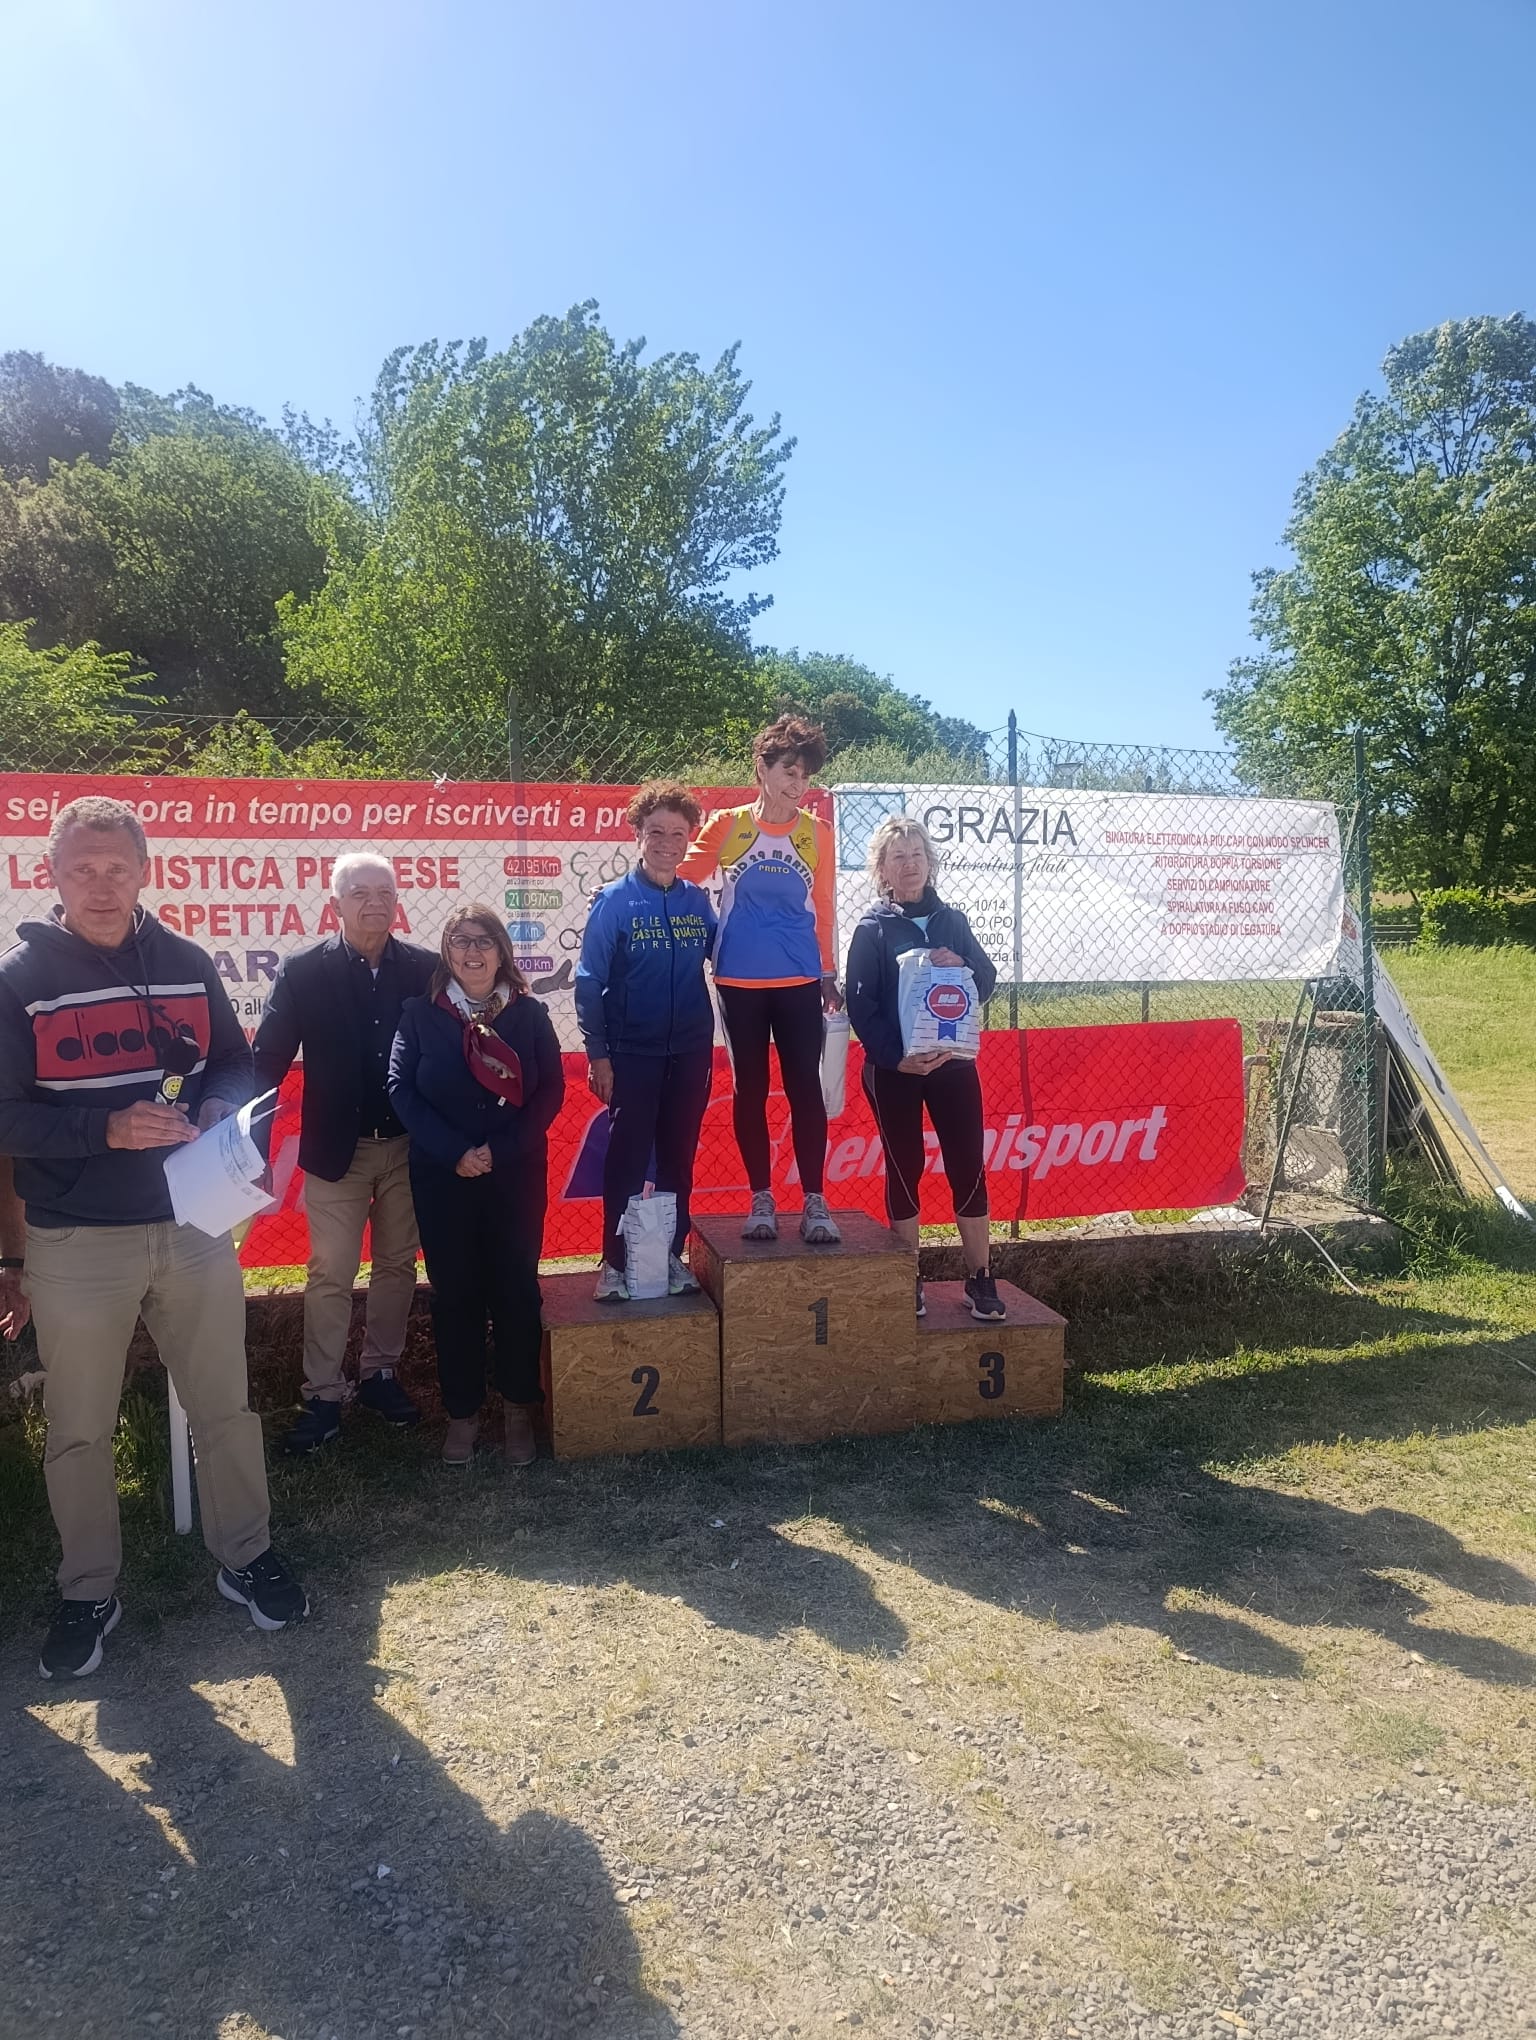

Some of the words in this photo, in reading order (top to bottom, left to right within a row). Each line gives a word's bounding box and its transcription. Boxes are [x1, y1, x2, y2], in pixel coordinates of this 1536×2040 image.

[206, 796, 236, 824] in
[248, 797, 350, 832] tempo
[361, 802, 416, 832] per
[425, 798, 561, 828] iscriverti
[569, 806, 586, 827] a
[923, 805, 1077, 846] GRAZIA
[1105, 831, 1145, 844] BINATURA
[1147, 833, 1201, 846] ELETTRONICA
[1247, 836, 1264, 848] CON
[1265, 836, 1288, 848] NODO
[758, 864, 790, 874] PRATO
[772, 849, 813, 889] MARTIRI
[1155, 856, 1208, 868] RITORCITURA
[1241, 857, 1281, 870] TORSIONE
[143, 855, 284, 890] ISTICA
[1167, 879, 1197, 891] SERVIZI
[1208, 879, 1271, 892] CAMPIONATURE
[975, 899, 1006, 911] 10/14
[1167, 901, 1220, 913] SPIRALATURA
[1228, 902, 1251, 914] FUSO
[1252, 902, 1275, 914] CAVO
[649, 915, 661, 927] LE
[989, 916, 1017, 930] (PO)
[510, 923, 521, 938] 7
[1169, 923, 1198, 935] DOPPIO
[1200, 923, 1228, 936] STADIO
[1230, 924, 1239, 936] DI
[1240, 924, 1282, 936] LEGATURA
[807, 1297, 829, 1345] 1
[978, 1352, 1006, 1399] 3
[630, 1365, 661, 1417] 2
